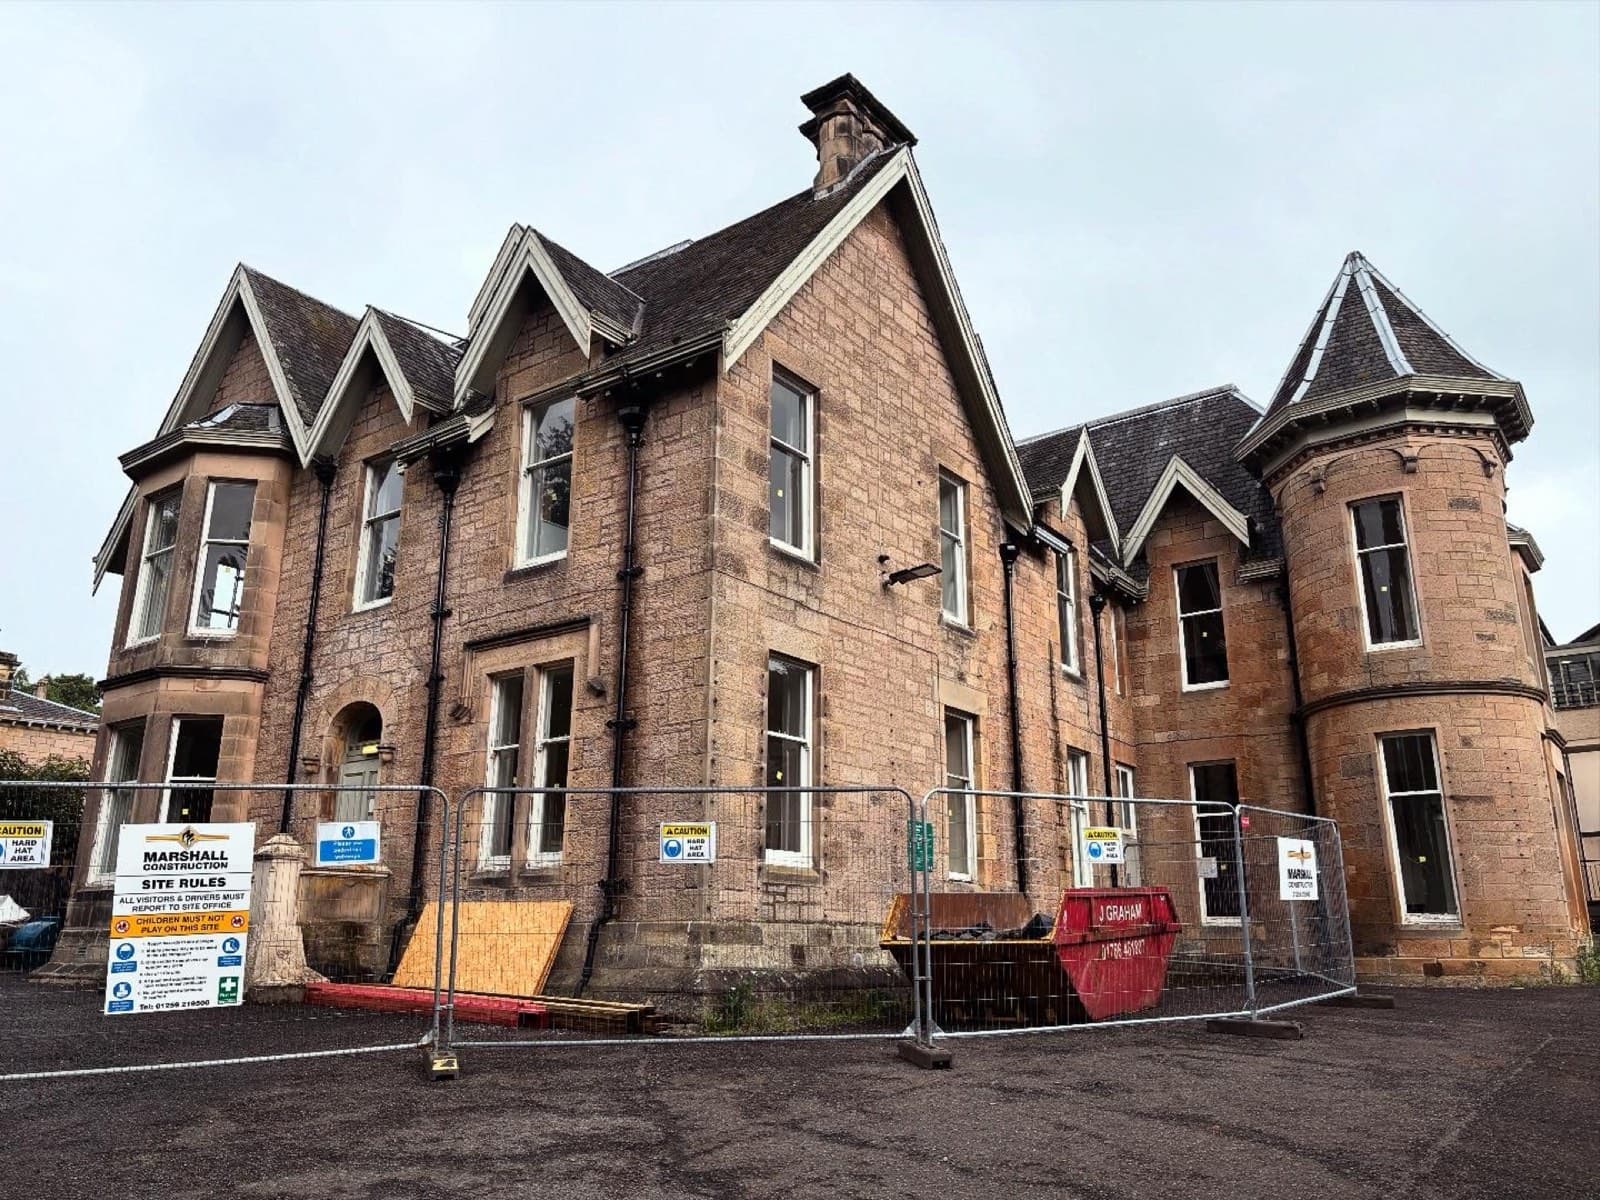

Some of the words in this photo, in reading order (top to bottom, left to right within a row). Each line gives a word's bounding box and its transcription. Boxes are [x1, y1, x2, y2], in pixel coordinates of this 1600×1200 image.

[0, 826, 42, 835] AUTION
[674, 827, 708, 835] CAUTION
[143, 850, 228, 863] MARSHALL
[143, 861, 228, 871] CONSTRUCTION
[142, 879, 174, 890] SITE
[179, 877, 226, 888] RULES
[119, 896, 135, 904] ALL
[136, 895, 175, 903] VISITORS
[185, 893, 221, 902] DRIVERS
[222, 892, 245, 901] MUST
[132, 904, 166, 912] REPORT
[169, 903, 180, 911] TO
[182, 902, 200, 911] SITE
[202, 901, 232, 910] OFFICE
[1099, 905, 1104, 922] J
[1106, 903, 1142, 921] GRAHAM
[136, 917, 180, 925] CHILDREN
[182, 915, 205, 923] MUST
[207, 914, 225, 922] NOT
[140, 925, 161, 934] PLAY
[164, 925, 178, 933] ON
[180, 924, 199, 932] THIS
[201, 923, 219, 931] SITE
[139, 1003, 154, 1011] Tel:
